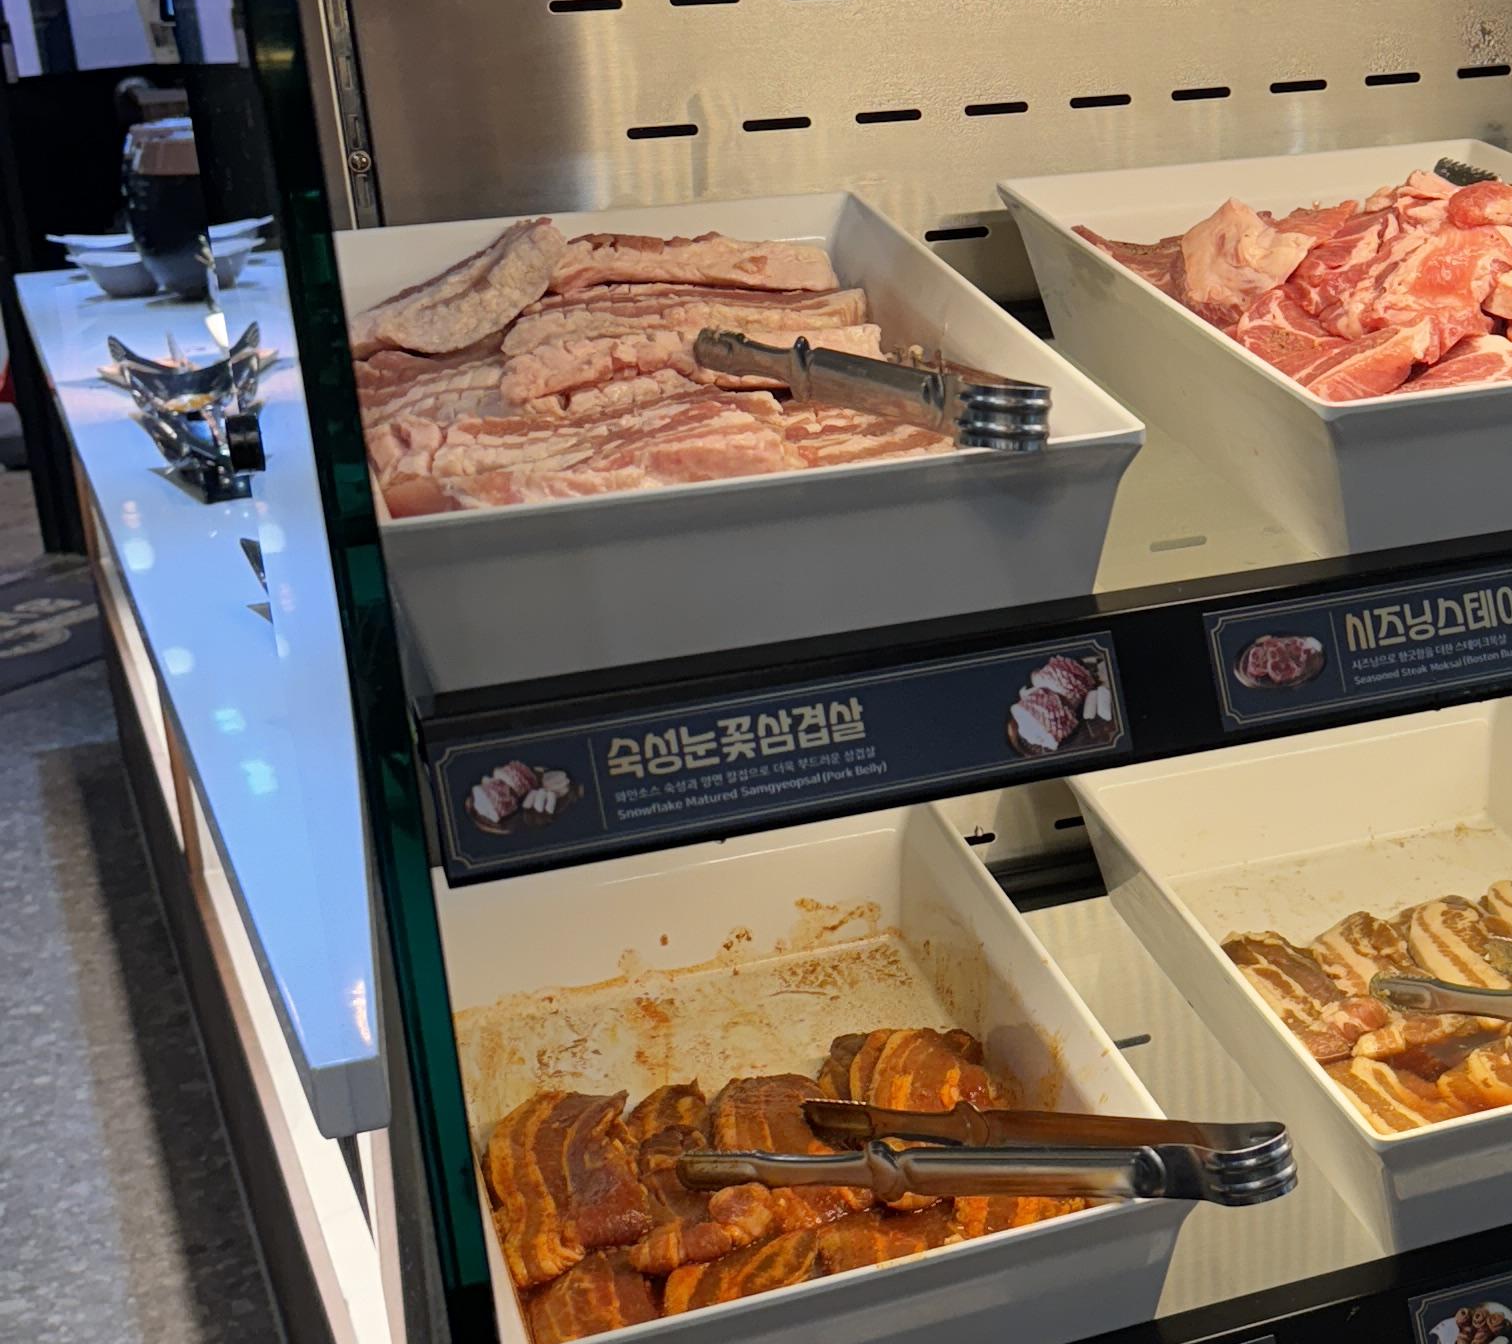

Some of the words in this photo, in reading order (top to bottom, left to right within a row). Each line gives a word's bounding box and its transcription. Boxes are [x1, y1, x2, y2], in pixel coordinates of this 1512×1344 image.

[1354, 669, 1400, 685] Seasoned
[1401, 664, 1428, 677] Steak
[608, 697, 866, 778] 숙성눈꽃삼겹살
[844, 746, 875, 762] 삼겹살
[618, 801, 683, 820] Snowflake
[685, 788, 738, 807] Matured
[855, 761, 887, 776] Belly)
